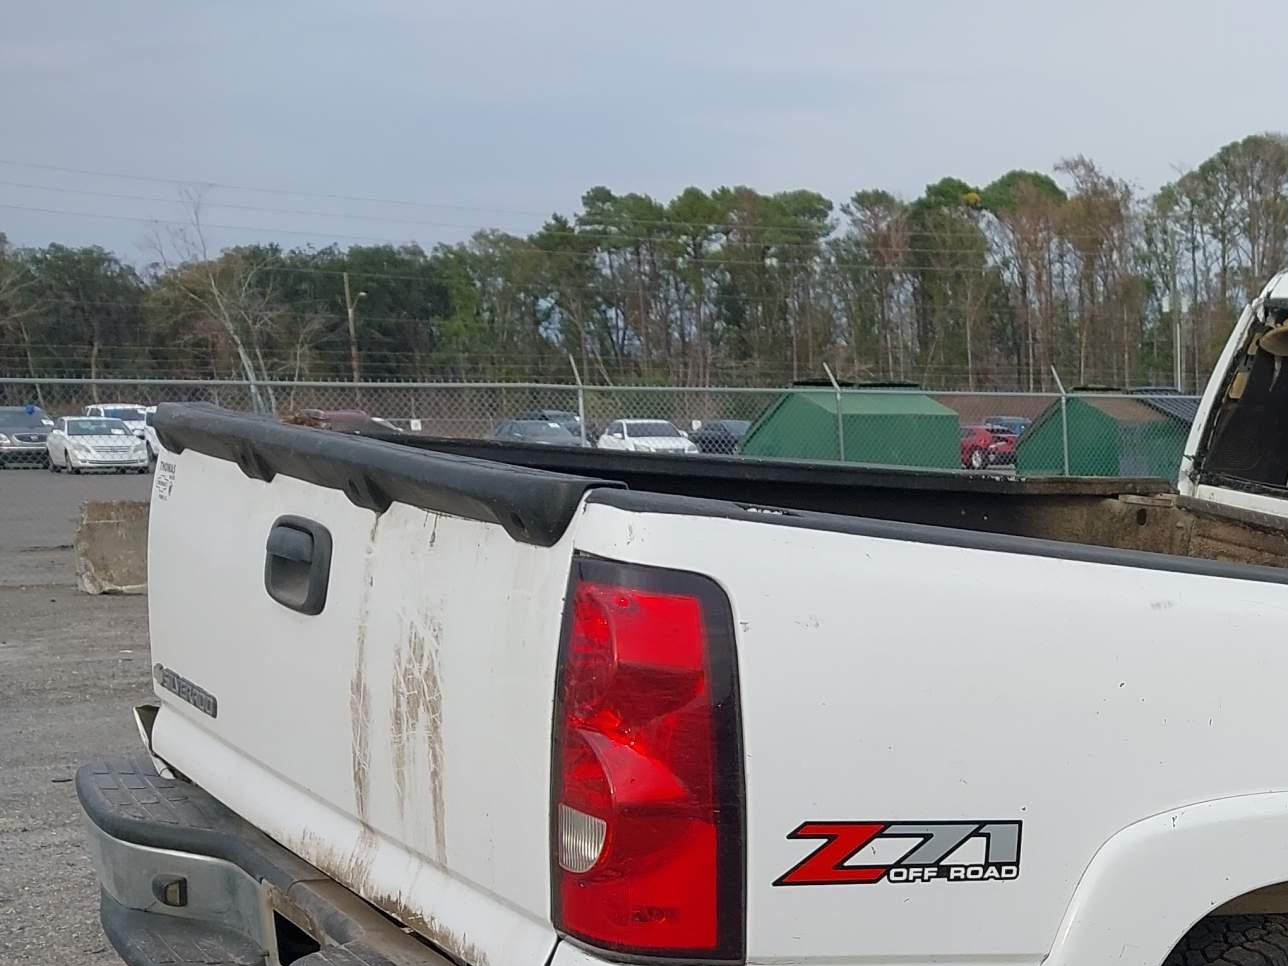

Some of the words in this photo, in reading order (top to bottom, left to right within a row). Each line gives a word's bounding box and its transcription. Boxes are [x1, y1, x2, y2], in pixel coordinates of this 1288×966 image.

[771, 819, 1023, 886] Z71
[888, 866, 939, 882] OFF
[949, 864, 1019, 880] ROAD
